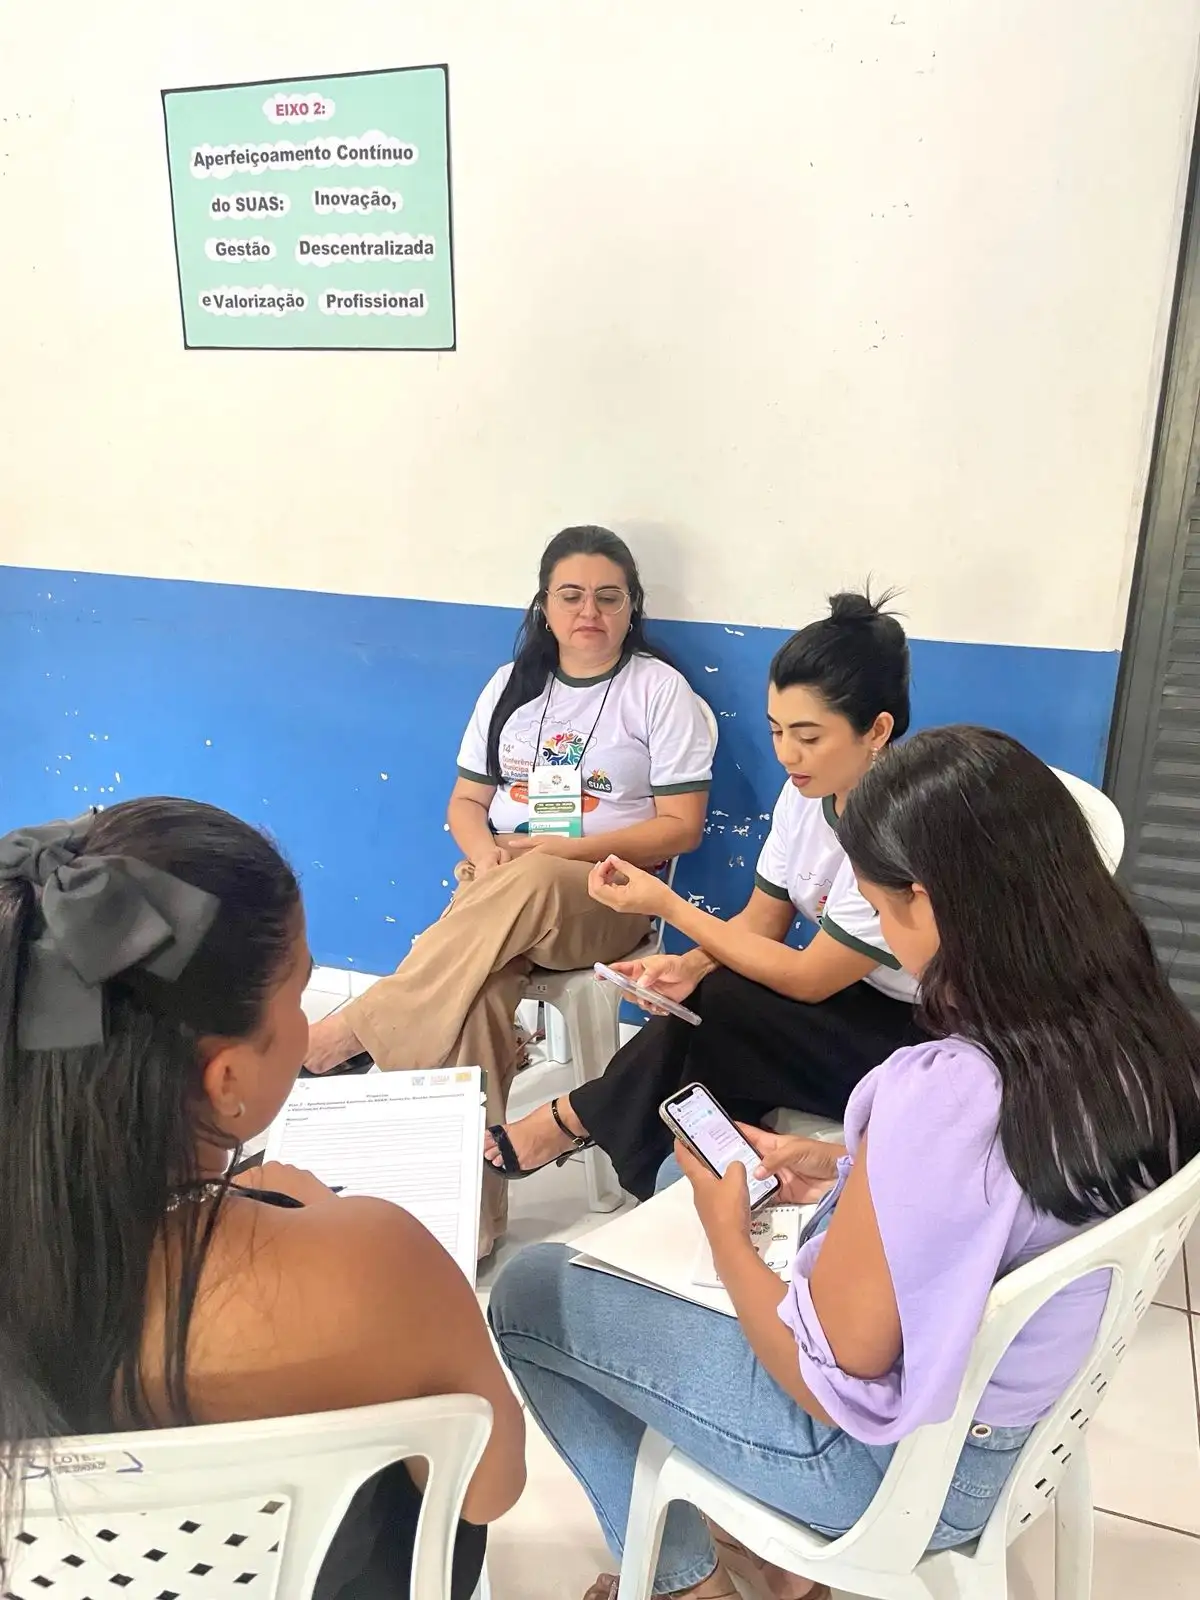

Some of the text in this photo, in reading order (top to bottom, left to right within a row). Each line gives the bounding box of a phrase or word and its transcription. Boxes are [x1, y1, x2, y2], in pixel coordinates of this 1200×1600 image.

[275, 101, 326, 117] EIXO 2:
[193, 144, 414, 170] Aperfeiçoamento Contínuo
[211, 190, 398, 213] do SUAS: Inovação,
[215, 240, 435, 257] Gestão Descentralizada
[326, 293, 425, 309] Profissional
[588, 780, 611, 791] SUAS
